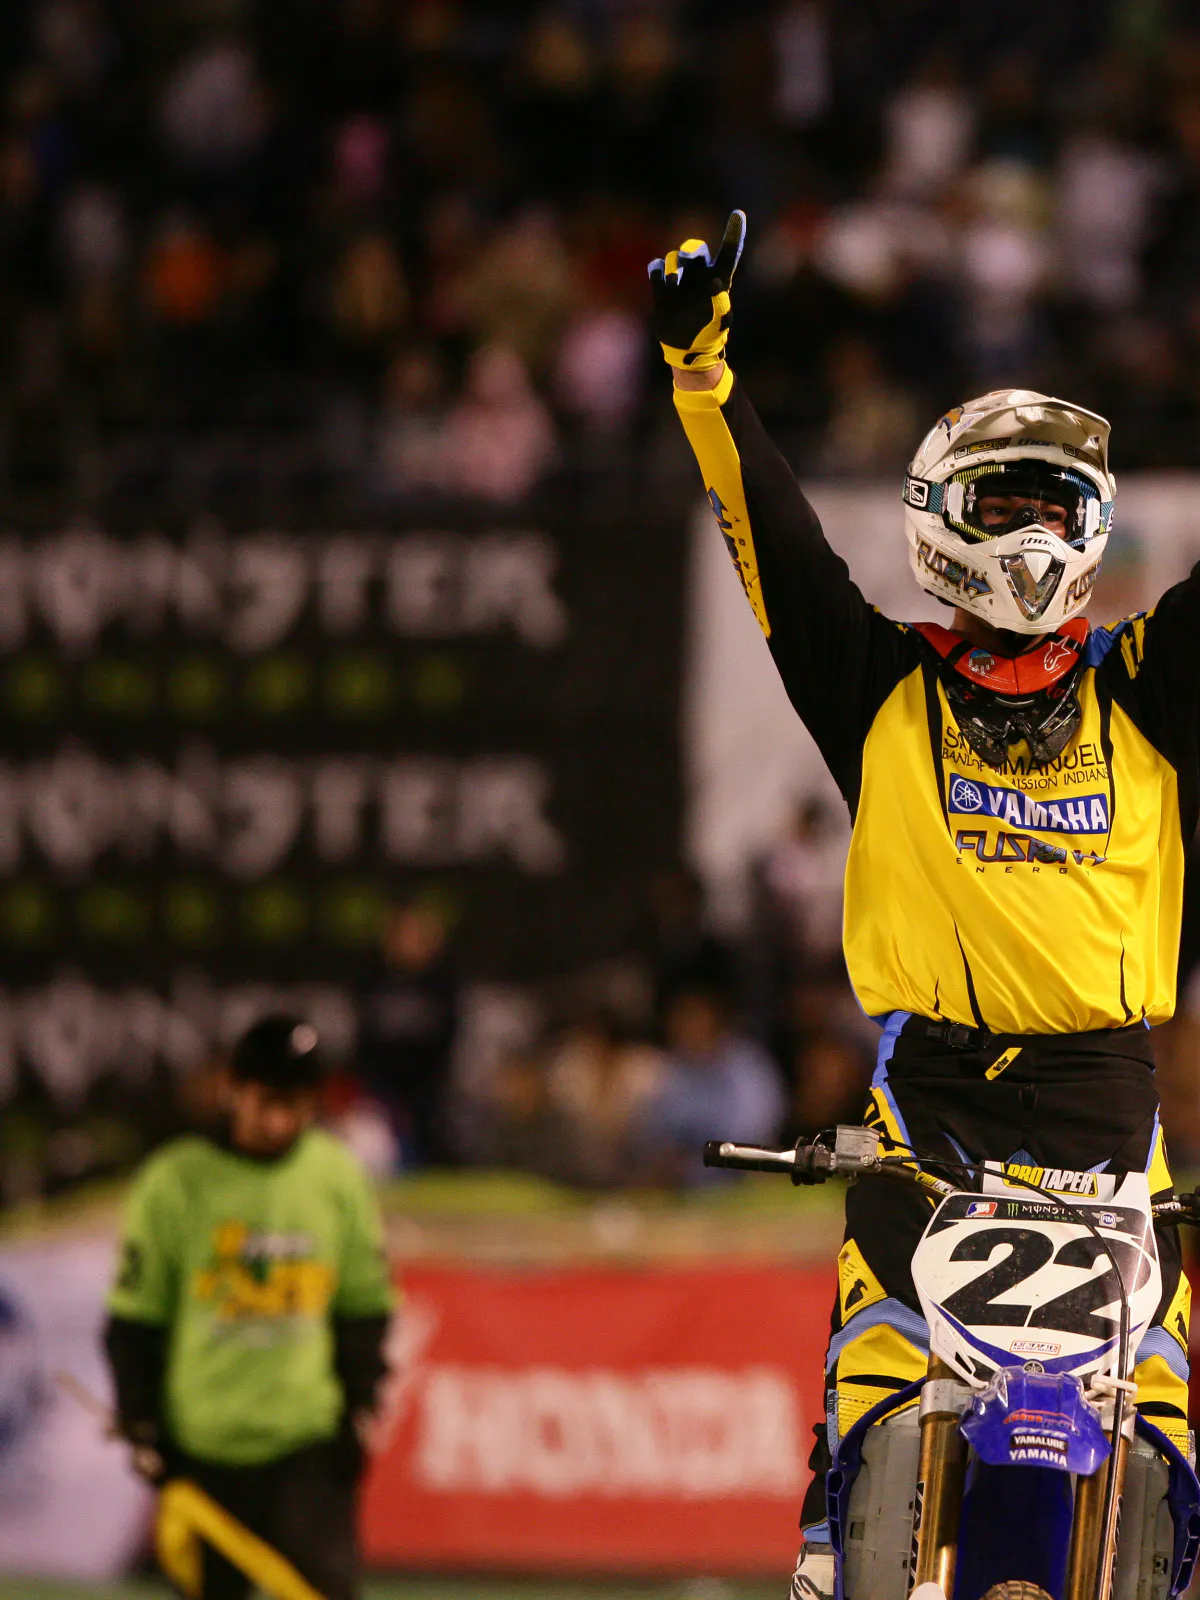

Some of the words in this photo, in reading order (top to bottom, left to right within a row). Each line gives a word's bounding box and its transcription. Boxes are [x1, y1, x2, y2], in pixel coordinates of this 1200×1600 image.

[988, 790, 1108, 831] YAMAHA
[956, 857, 1090, 876] ENERG
[940, 1227, 1151, 1340] 22
[1014, 1435, 1065, 1451] YAMALUBE
[1009, 1449, 1067, 1467] YAMAHA
